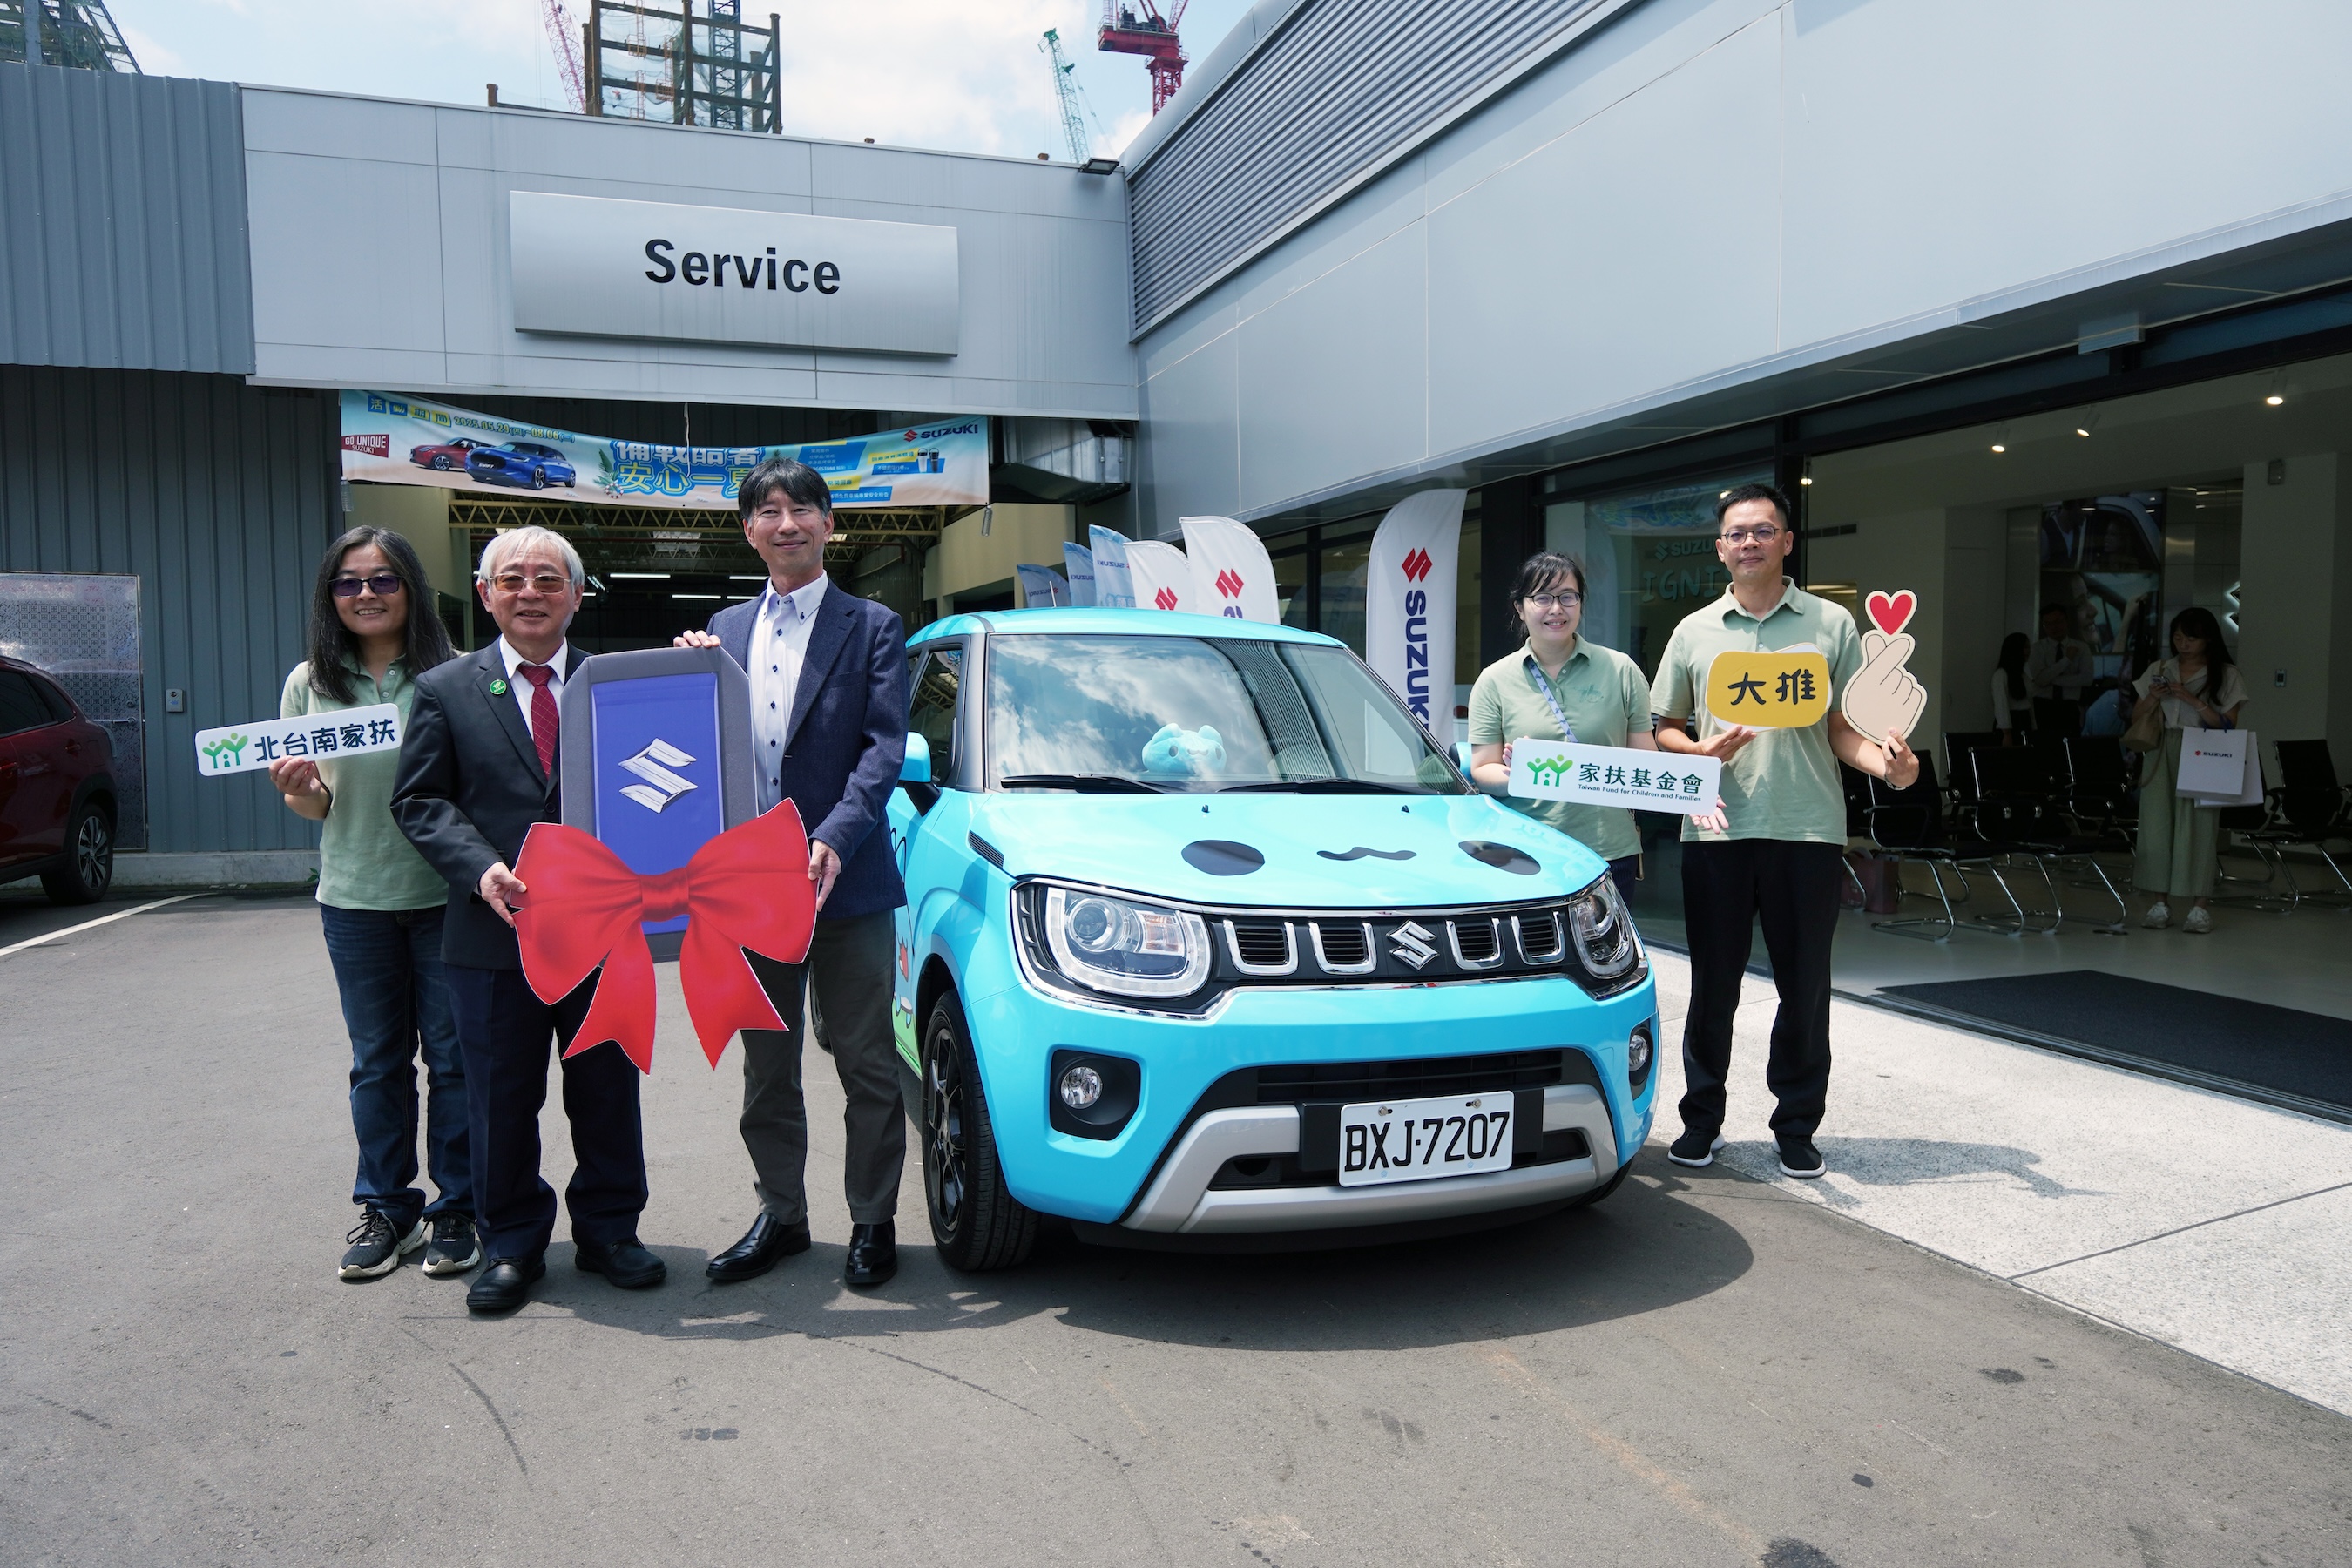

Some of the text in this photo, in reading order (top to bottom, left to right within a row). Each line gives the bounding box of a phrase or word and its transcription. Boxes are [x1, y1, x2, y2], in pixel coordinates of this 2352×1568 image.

[645, 238, 841, 294] Service
[356, 436, 386, 449] UNIQUE
[920, 424, 978, 439] SUZUKI
[351, 445, 374, 454] SUZUKI
[1671, 538, 1715, 557] SUZU
[1641, 564, 1732, 604] IGNI
[1405, 590, 1429, 731] SUZUK
[1727, 668, 1816, 706] 大推
[254, 719, 396, 762] 北台南家扶
[1578, 762, 1704, 794] 家扶基金會
[1632, 789, 1659, 798] Children
[1674, 794, 1701, 802] Families
